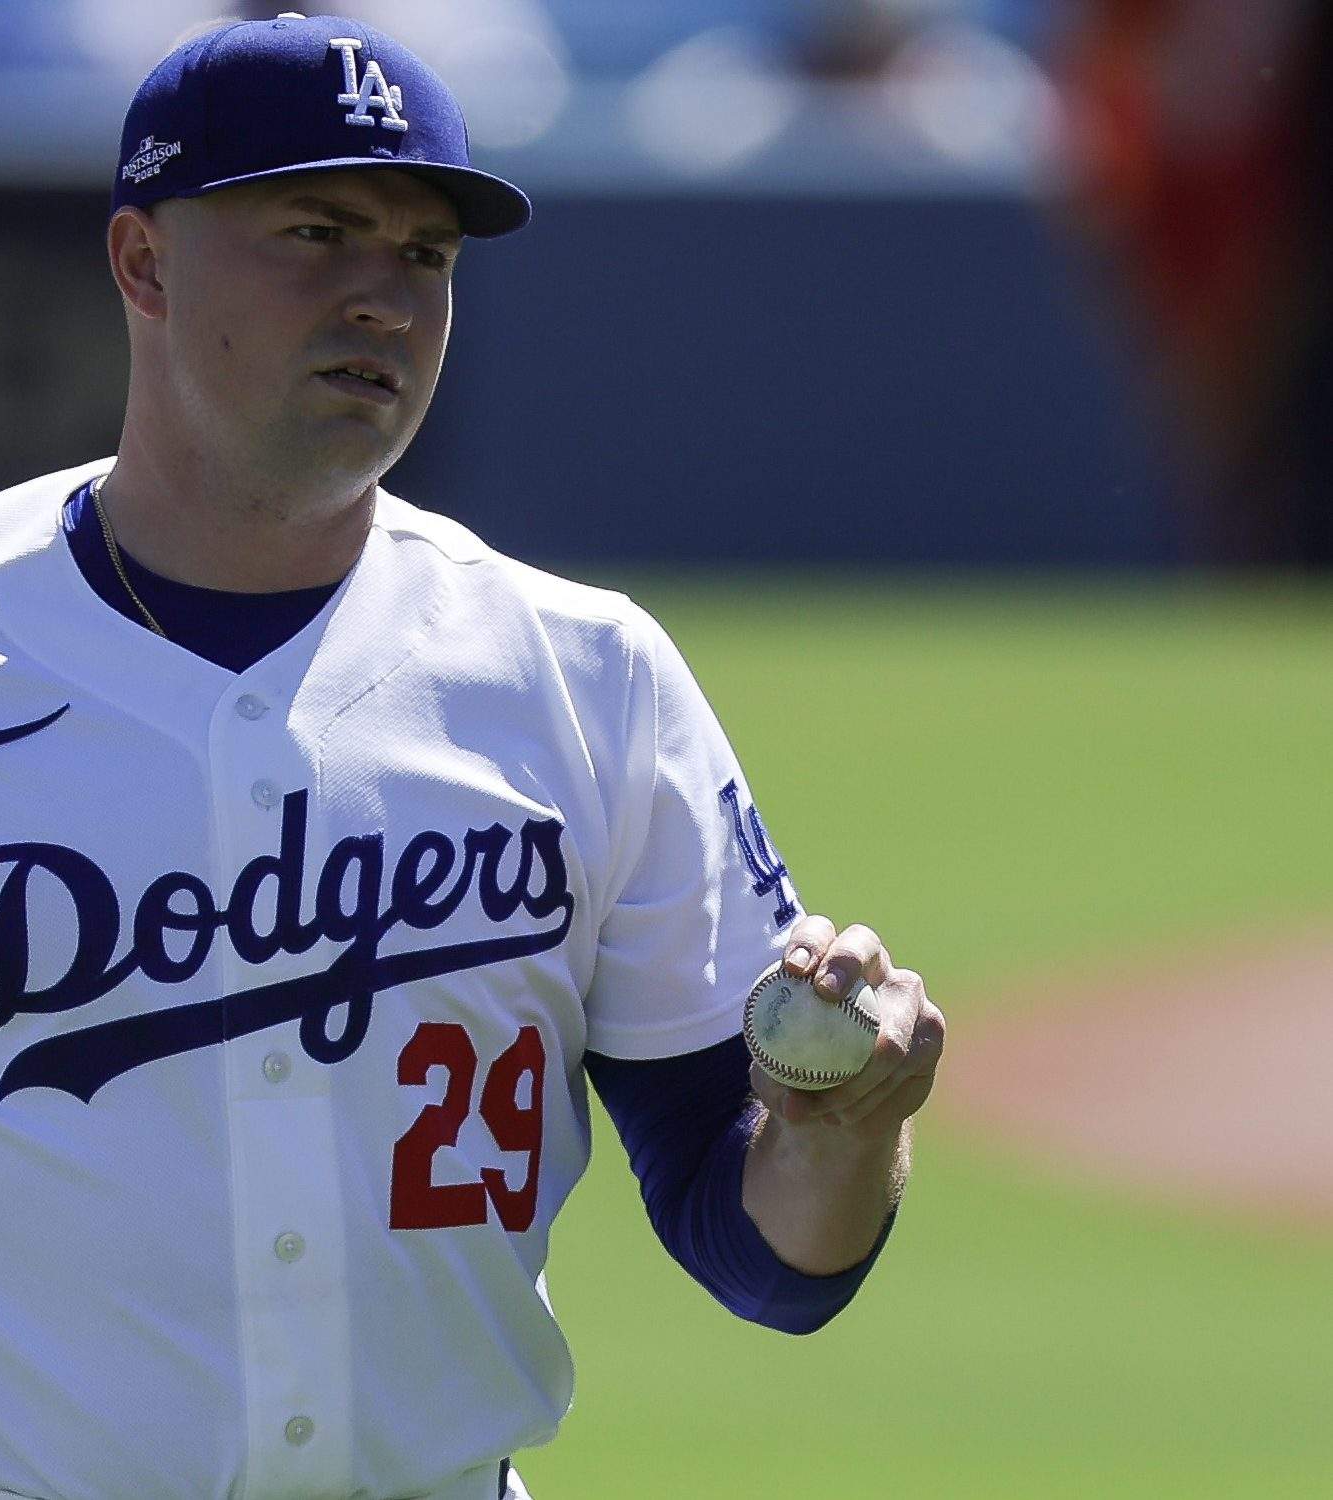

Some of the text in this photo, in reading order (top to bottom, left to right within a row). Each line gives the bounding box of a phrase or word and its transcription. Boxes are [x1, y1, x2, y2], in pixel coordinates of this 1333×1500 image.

[329, 37, 408, 132] LA
[122, 141, 182, 180] POSTSEASON
[389, 1021, 546, 1233] 29
